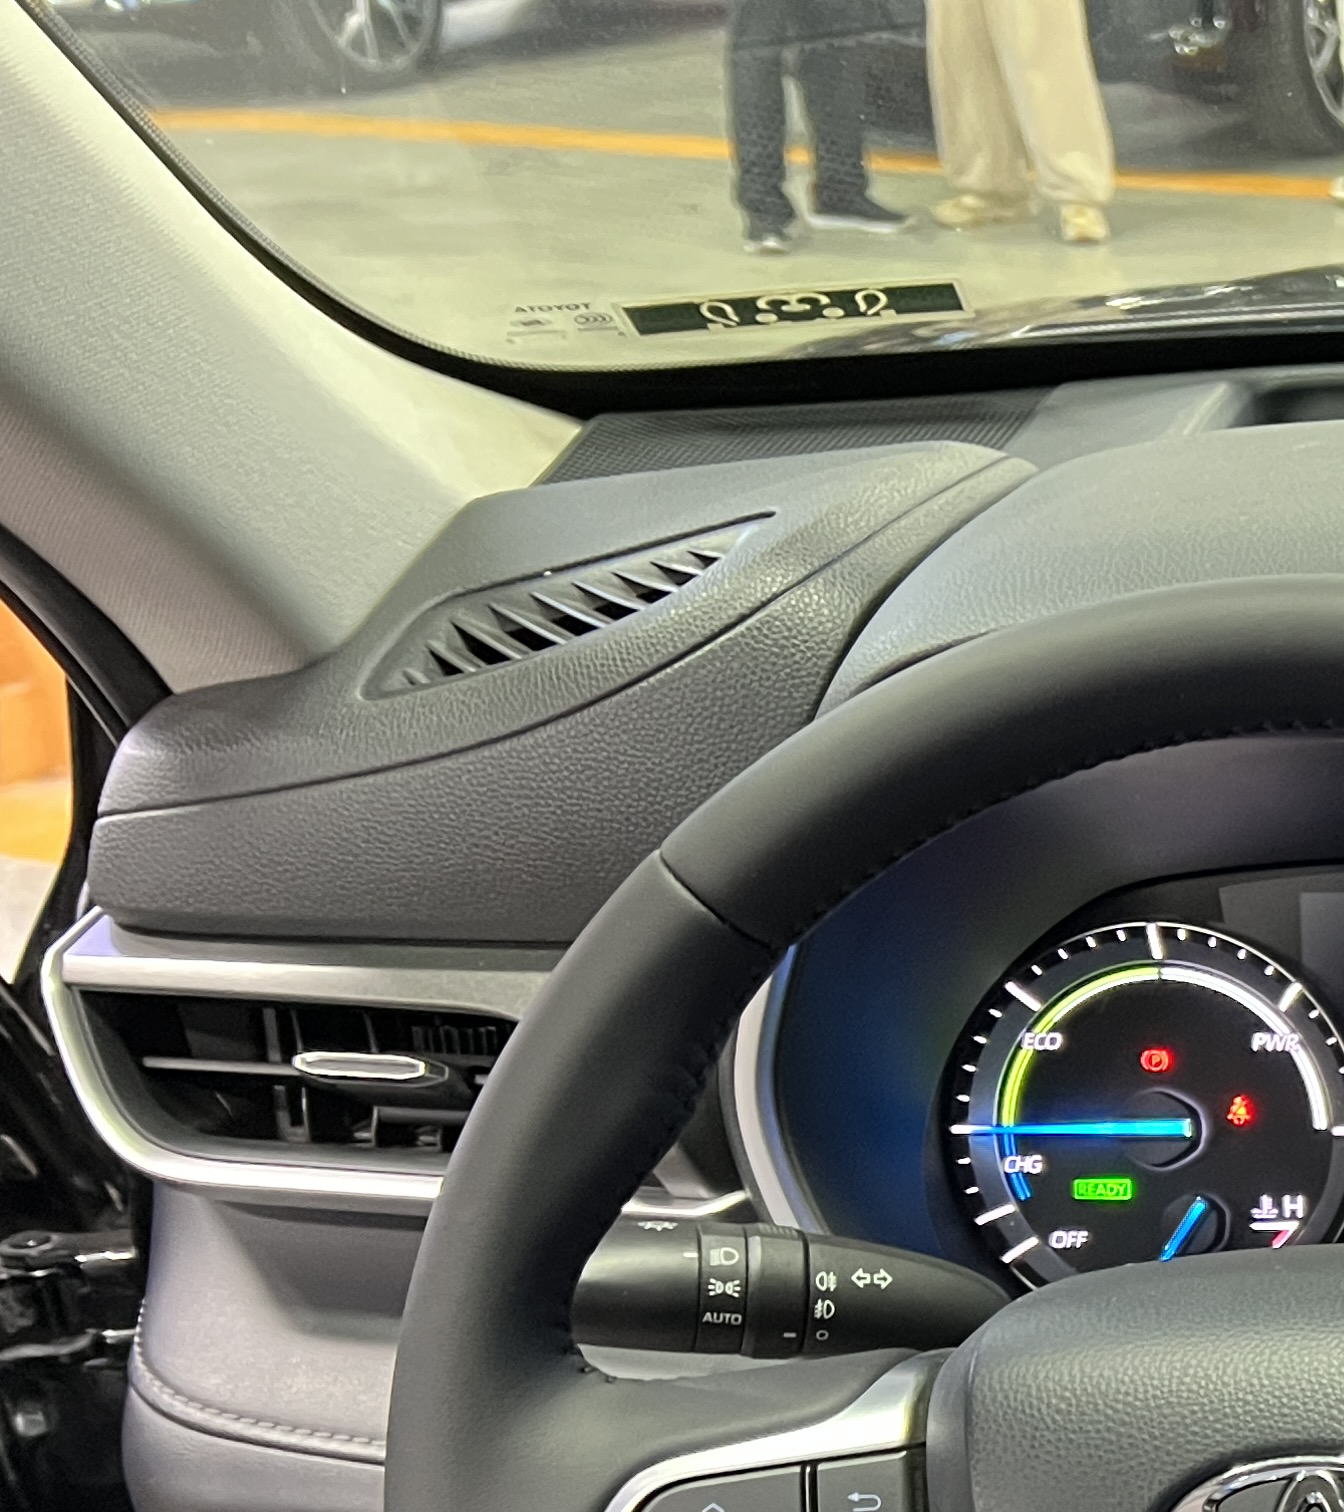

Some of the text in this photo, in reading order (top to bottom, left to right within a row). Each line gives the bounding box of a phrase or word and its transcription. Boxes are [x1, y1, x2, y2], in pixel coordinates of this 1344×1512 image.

[1021, 1033, 1062, 1051] ECO
[1252, 1034, 1301, 1052] PWR
[1004, 1155, 1043, 1174] CHG
[1079, 1182, 1127, 1198] READY
[1283, 1196, 1305, 1218] H
[1049, 1231, 1088, 1249] OFF
[702, 1312, 742, 1326] AUTO
